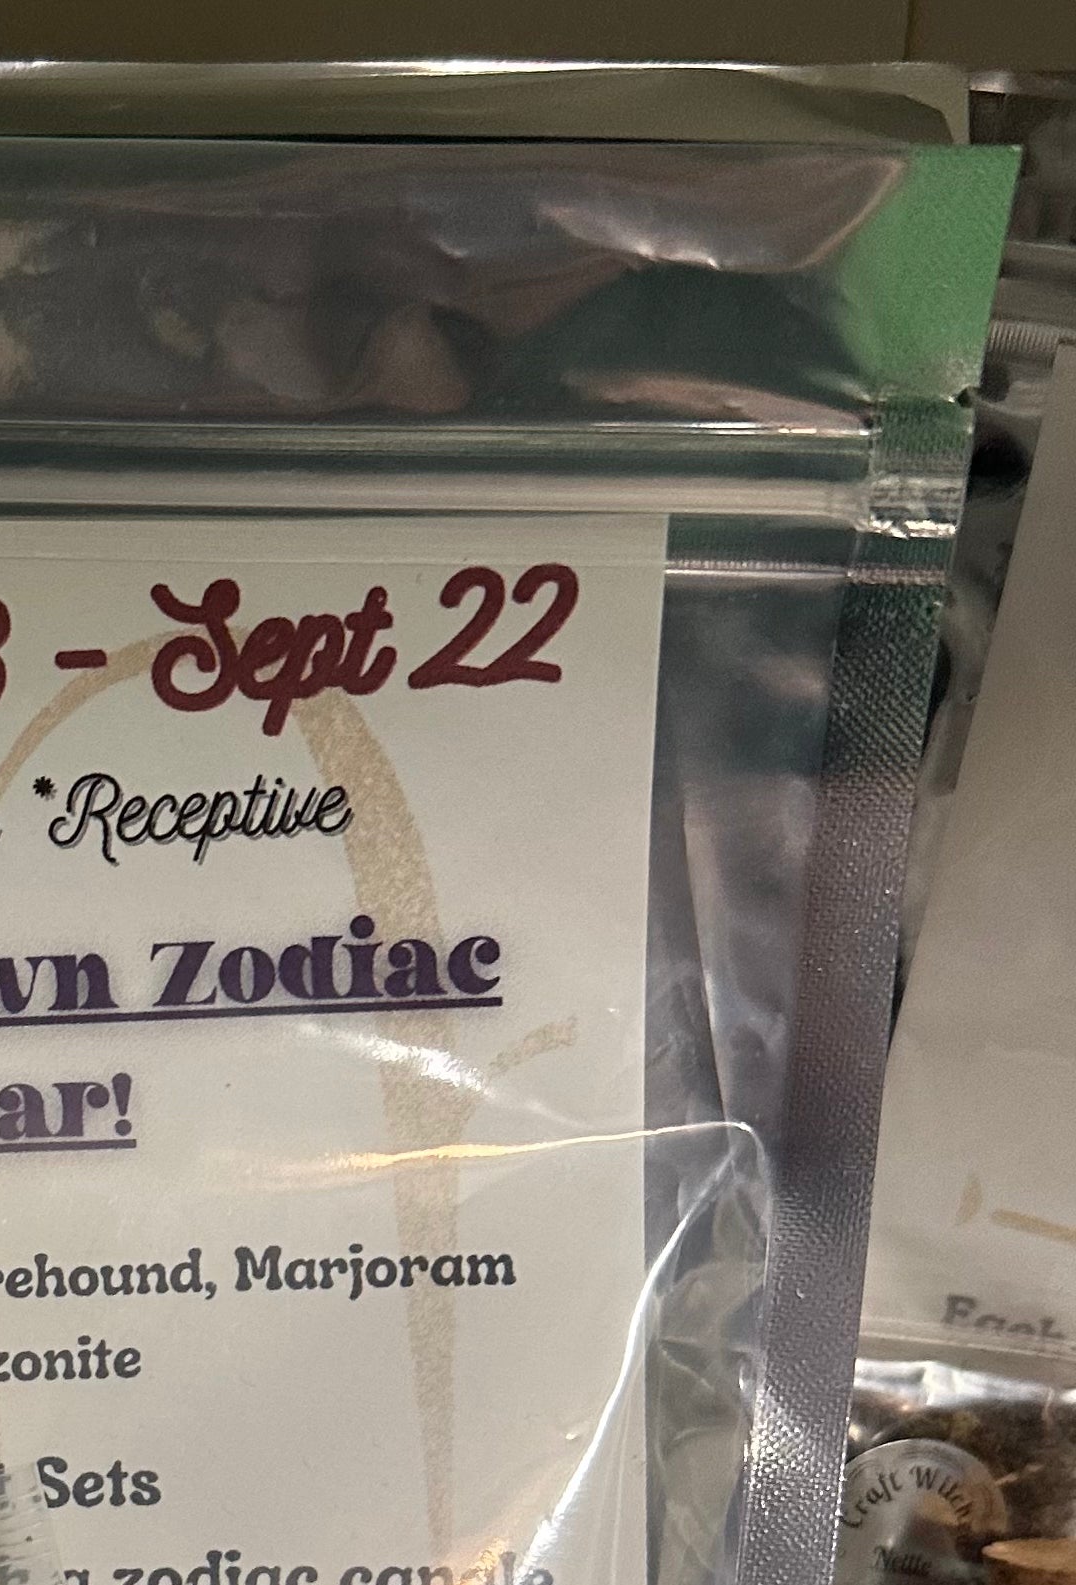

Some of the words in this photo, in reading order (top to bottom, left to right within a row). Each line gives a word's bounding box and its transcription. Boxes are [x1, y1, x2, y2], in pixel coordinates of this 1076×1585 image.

[151, 579, 397, 736] Sept
[407, 563, 579, 689] 22
[150, 914, 502, 1007] Zodiac
[234, 1244, 516, 1300] Marjoram
[36, 1456, 162, 1508] Sets
